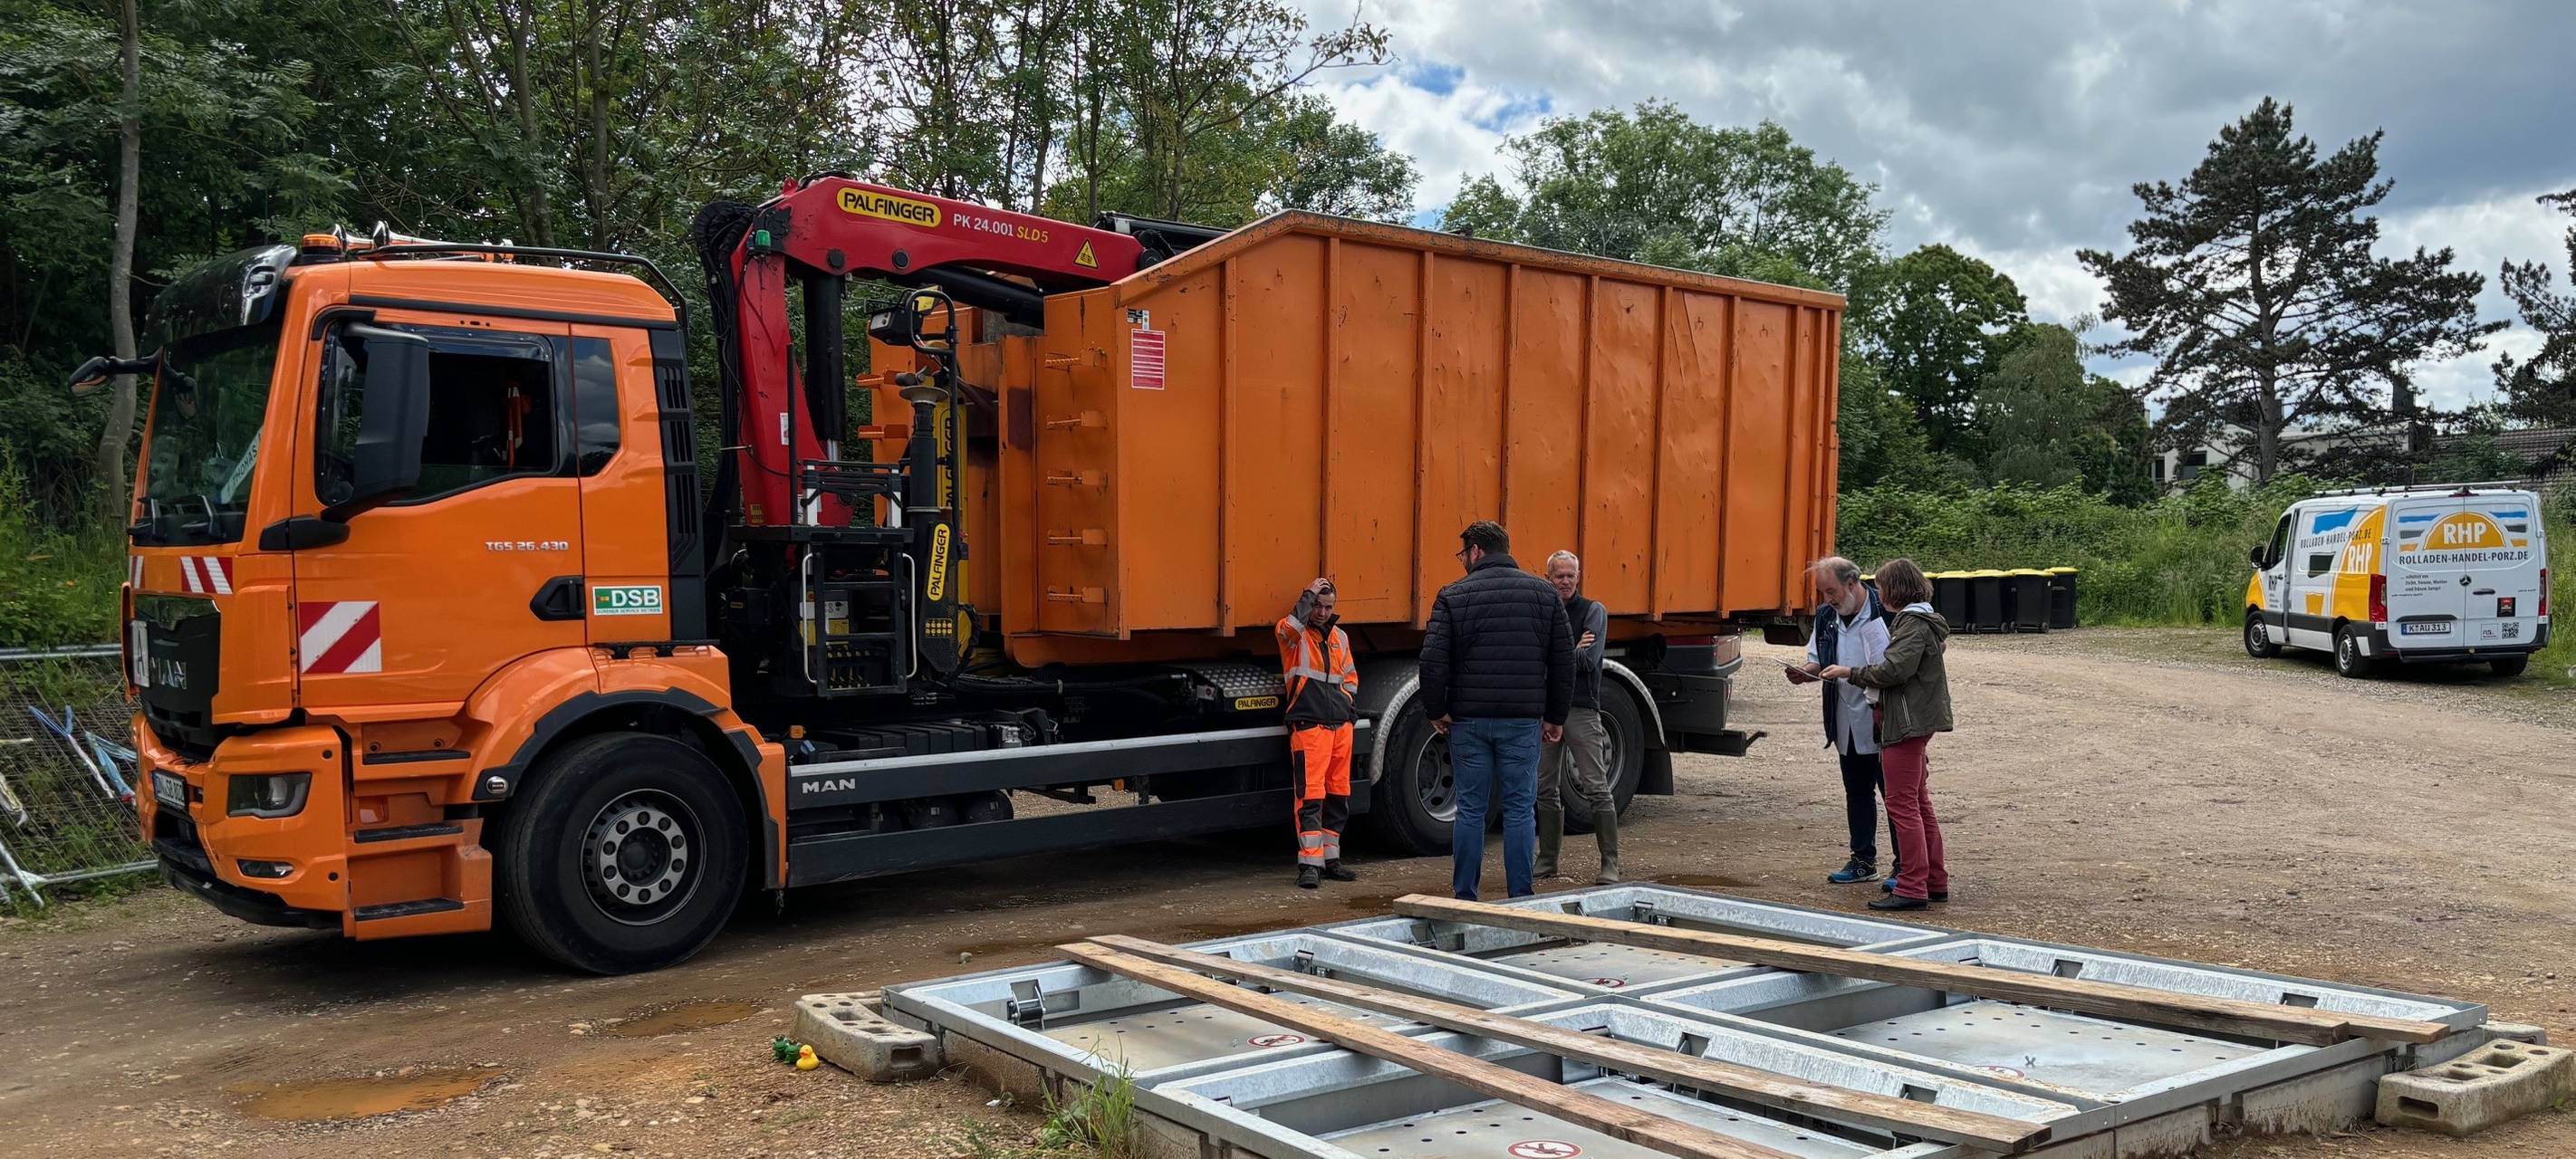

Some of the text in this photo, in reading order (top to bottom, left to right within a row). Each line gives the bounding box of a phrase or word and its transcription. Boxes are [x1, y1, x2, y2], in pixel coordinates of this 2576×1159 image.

[843, 195, 935, 224] PALFINGER
[954, 213, 970, 228] PK
[974, 217, 1014, 236] 24.001
[2443, 522, 2487, 544] RHP
[485, 541, 569, 551] TGS 26.430
[931, 528, 947, 597] PALFINGER
[2348, 542, 2373, 573] RHP
[2399, 551, 2529, 565] ROLLADEN-HANDEL-PORZ.DE
[610, 589, 659, 607] DSB
[2431, 622, 2446, 631] 313
[1237, 696, 1276, 708] PALFINGER
[803, 778, 856, 793] MAN
